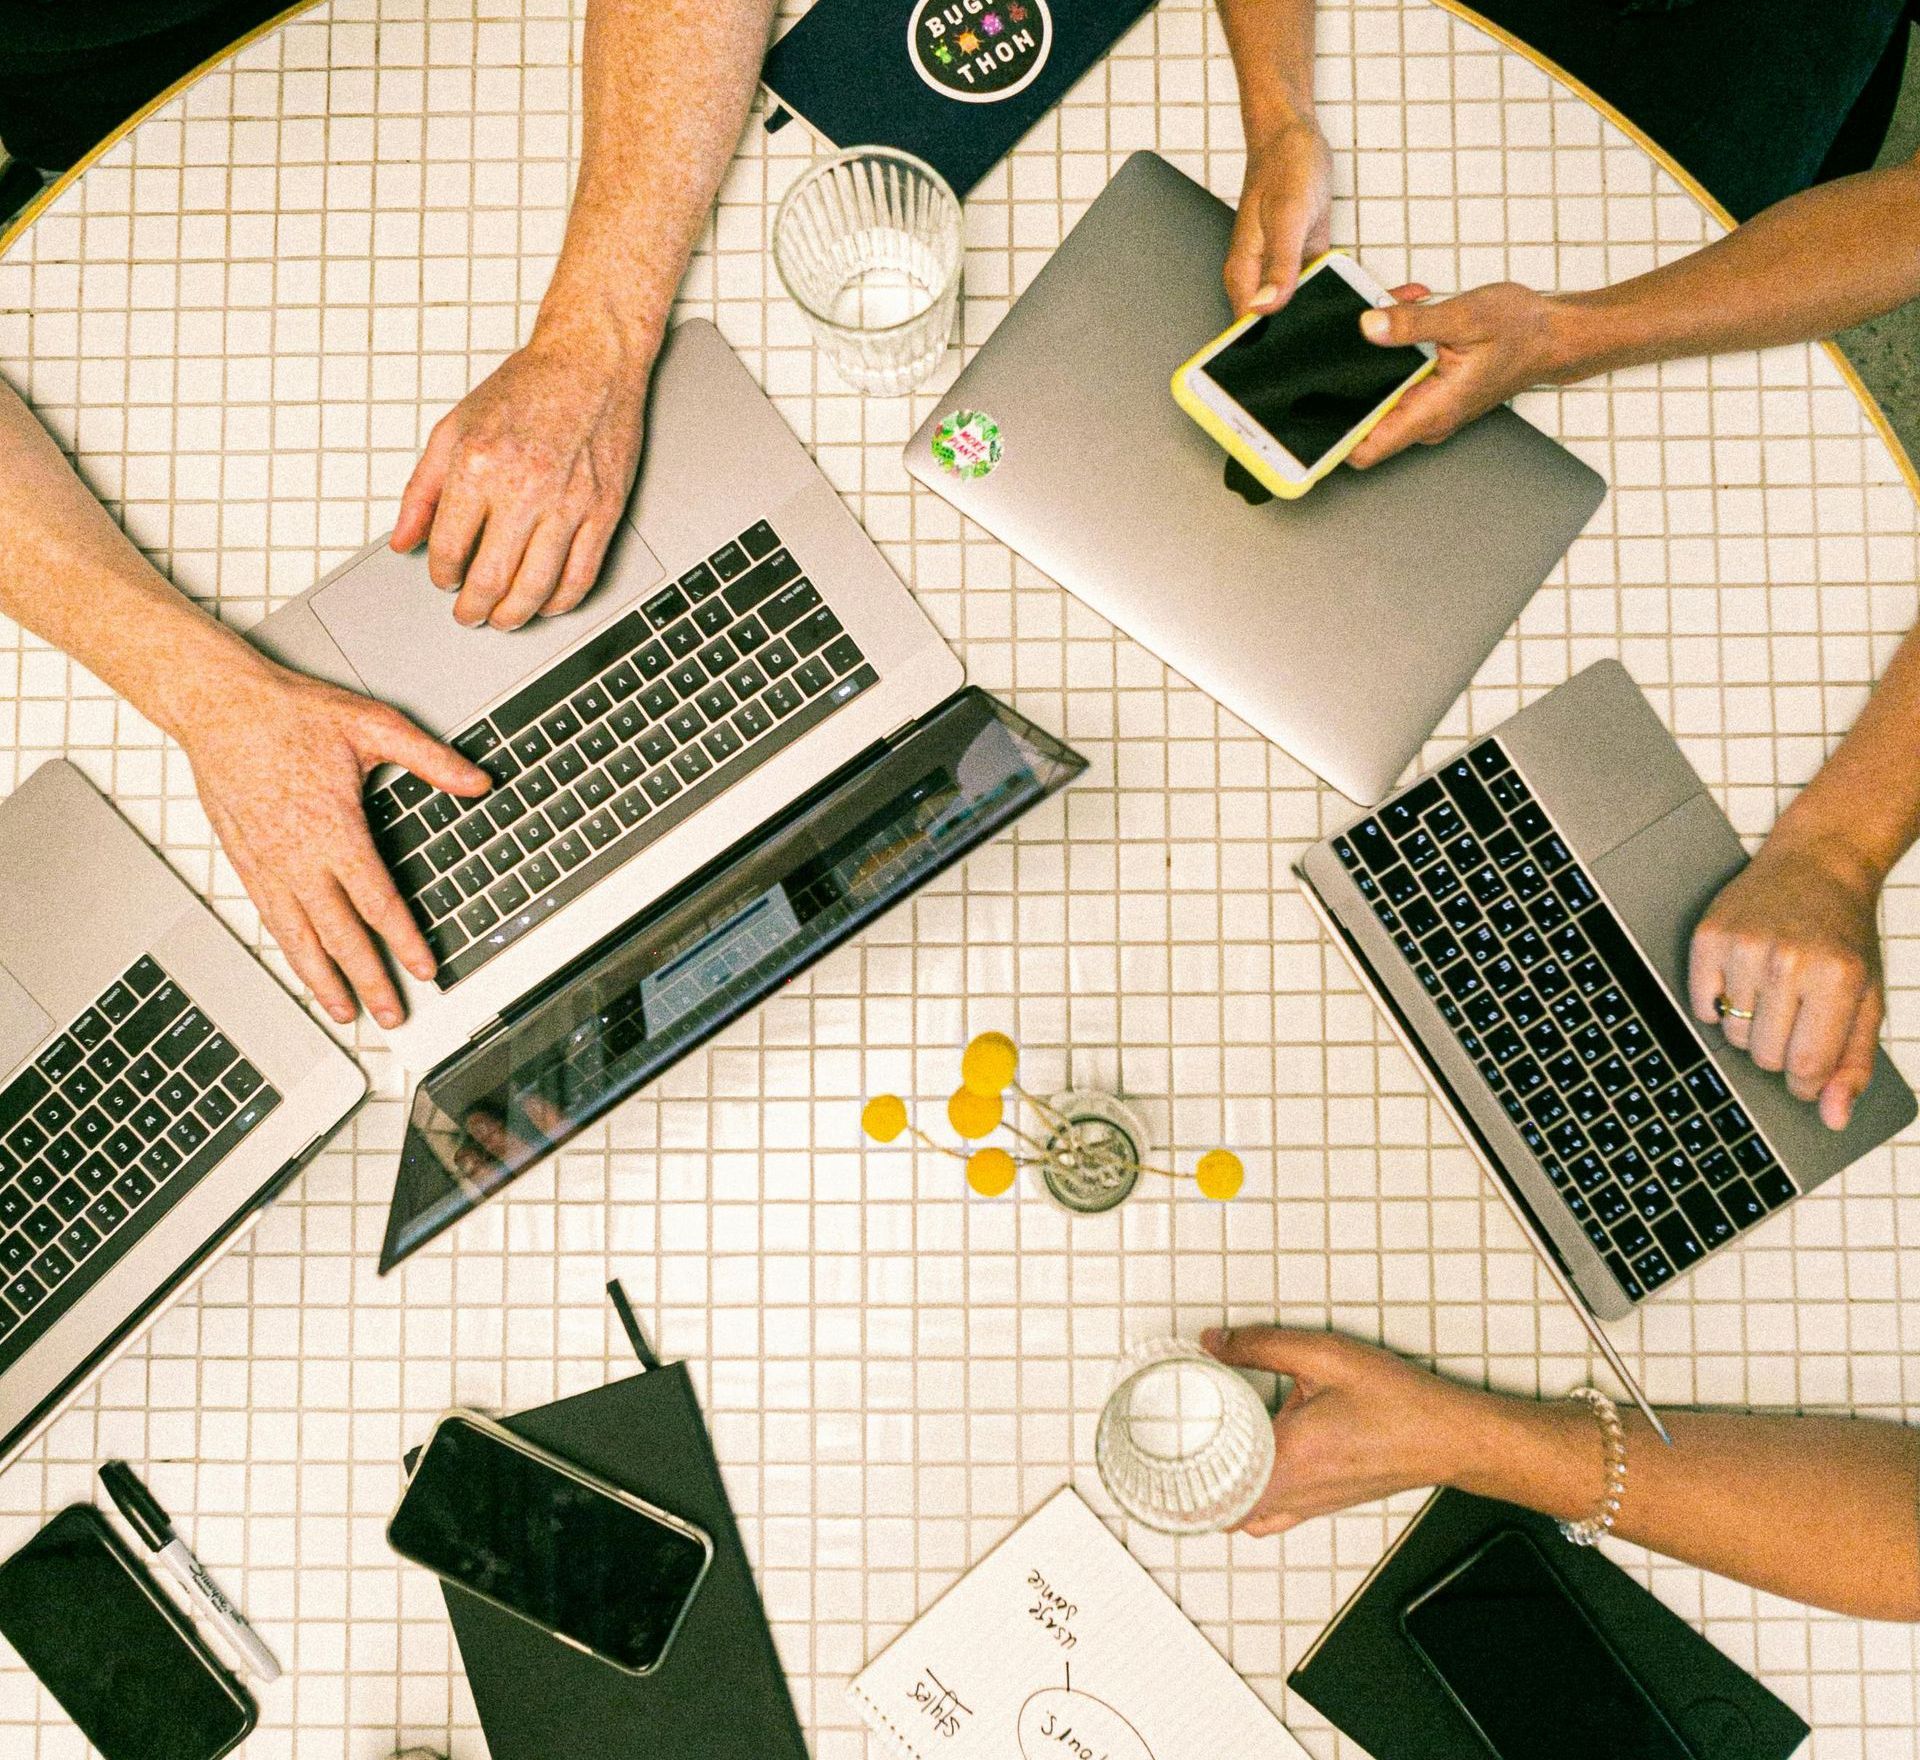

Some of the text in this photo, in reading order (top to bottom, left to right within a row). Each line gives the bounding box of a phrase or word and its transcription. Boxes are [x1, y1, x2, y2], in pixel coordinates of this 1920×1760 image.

[925, 0, 993, 38] BUG
[957, 29, 1035, 83] THON
[707, 612, 717, 622] Z
[677, 634, 687, 644] X
[743, 630, 752, 639] A
[647, 655, 656, 665] C
[713, 651, 723, 661] S
[771, 653, 781, 663] Q
[618, 678, 627, 687] V
[683, 673, 693, 683] D
[741, 675, 752, 686] W
[586, 698, 597, 708] B
[655, 695, 662, 705] F
[711, 696, 721, 707] E
[555, 720, 566, 730] N
[622, 716, 632, 726] G
[681, 718, 691, 728] R
[525, 741, 536, 752] M
[591, 738, 602, 748] H
[652, 741, 660, 750] T
[562, 760, 568, 770] J
[622, 763, 630, 772] Y
[531, 669, 813, 872] 1 2 3 4 5 6 7 8 9 0
[531, 782, 541, 791] K
[589, 784, 600, 794] U
[501, 803, 510, 811] L
[561, 806, 568, 814] I
[529, 827, 539, 837] O
[500, 849, 509, 859] P
[102, 1057, 112, 1067] Z
[140, 1069, 149, 1078] A
[75, 1083, 86, 1093] X
[171, 1089, 181, 1099] Q
[113, 1096, 123, 1106] S
[49, 1110, 59, 1119] C
[144, 1115, 156, 1127] W
[87, 1122, 97, 1132] D
[23, 1137, 32, 1146] V
[118, 1142, 128, 1152] E
[62, 1149, 69, 1158] F
[91, 1169, 101, 1178] R
[32, 1175, 42, 1185] G
[16, 1099, 215, 1293] 1 2 3 4 5 6 7 8
[65, 1196, 74, 1205] T
[5, 1201, 16, 1212] H
[38, 1223, 47, 1232] Y
[9, 1248, 19, 1258] U
[1041, 1711, 1108, 1760] ours.
